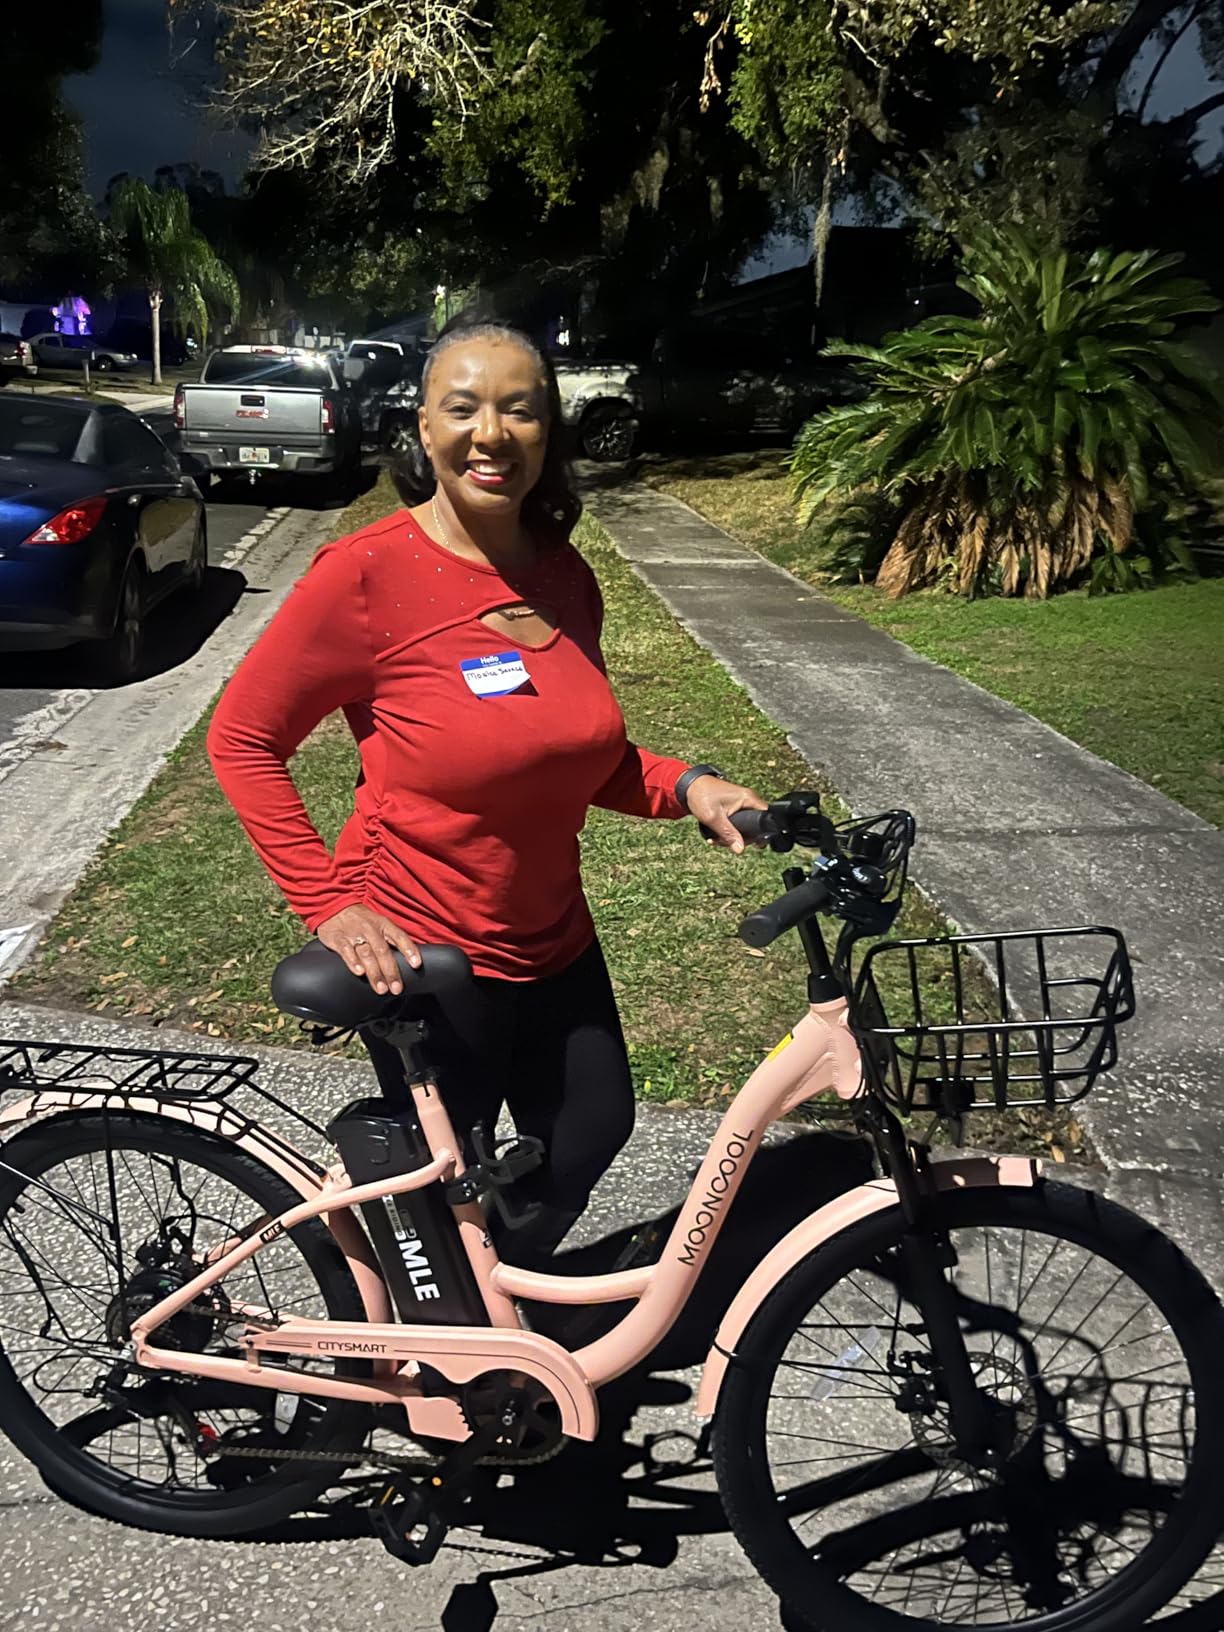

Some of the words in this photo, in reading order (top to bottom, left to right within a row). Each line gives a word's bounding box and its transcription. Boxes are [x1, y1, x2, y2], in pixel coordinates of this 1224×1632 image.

[480, 655, 500, 665] Hello
[677, 1129, 755, 1266] MOONCOOL
[398, 1239, 441, 1302] MLE
[317, 1341, 388, 1354] CITYSMART
